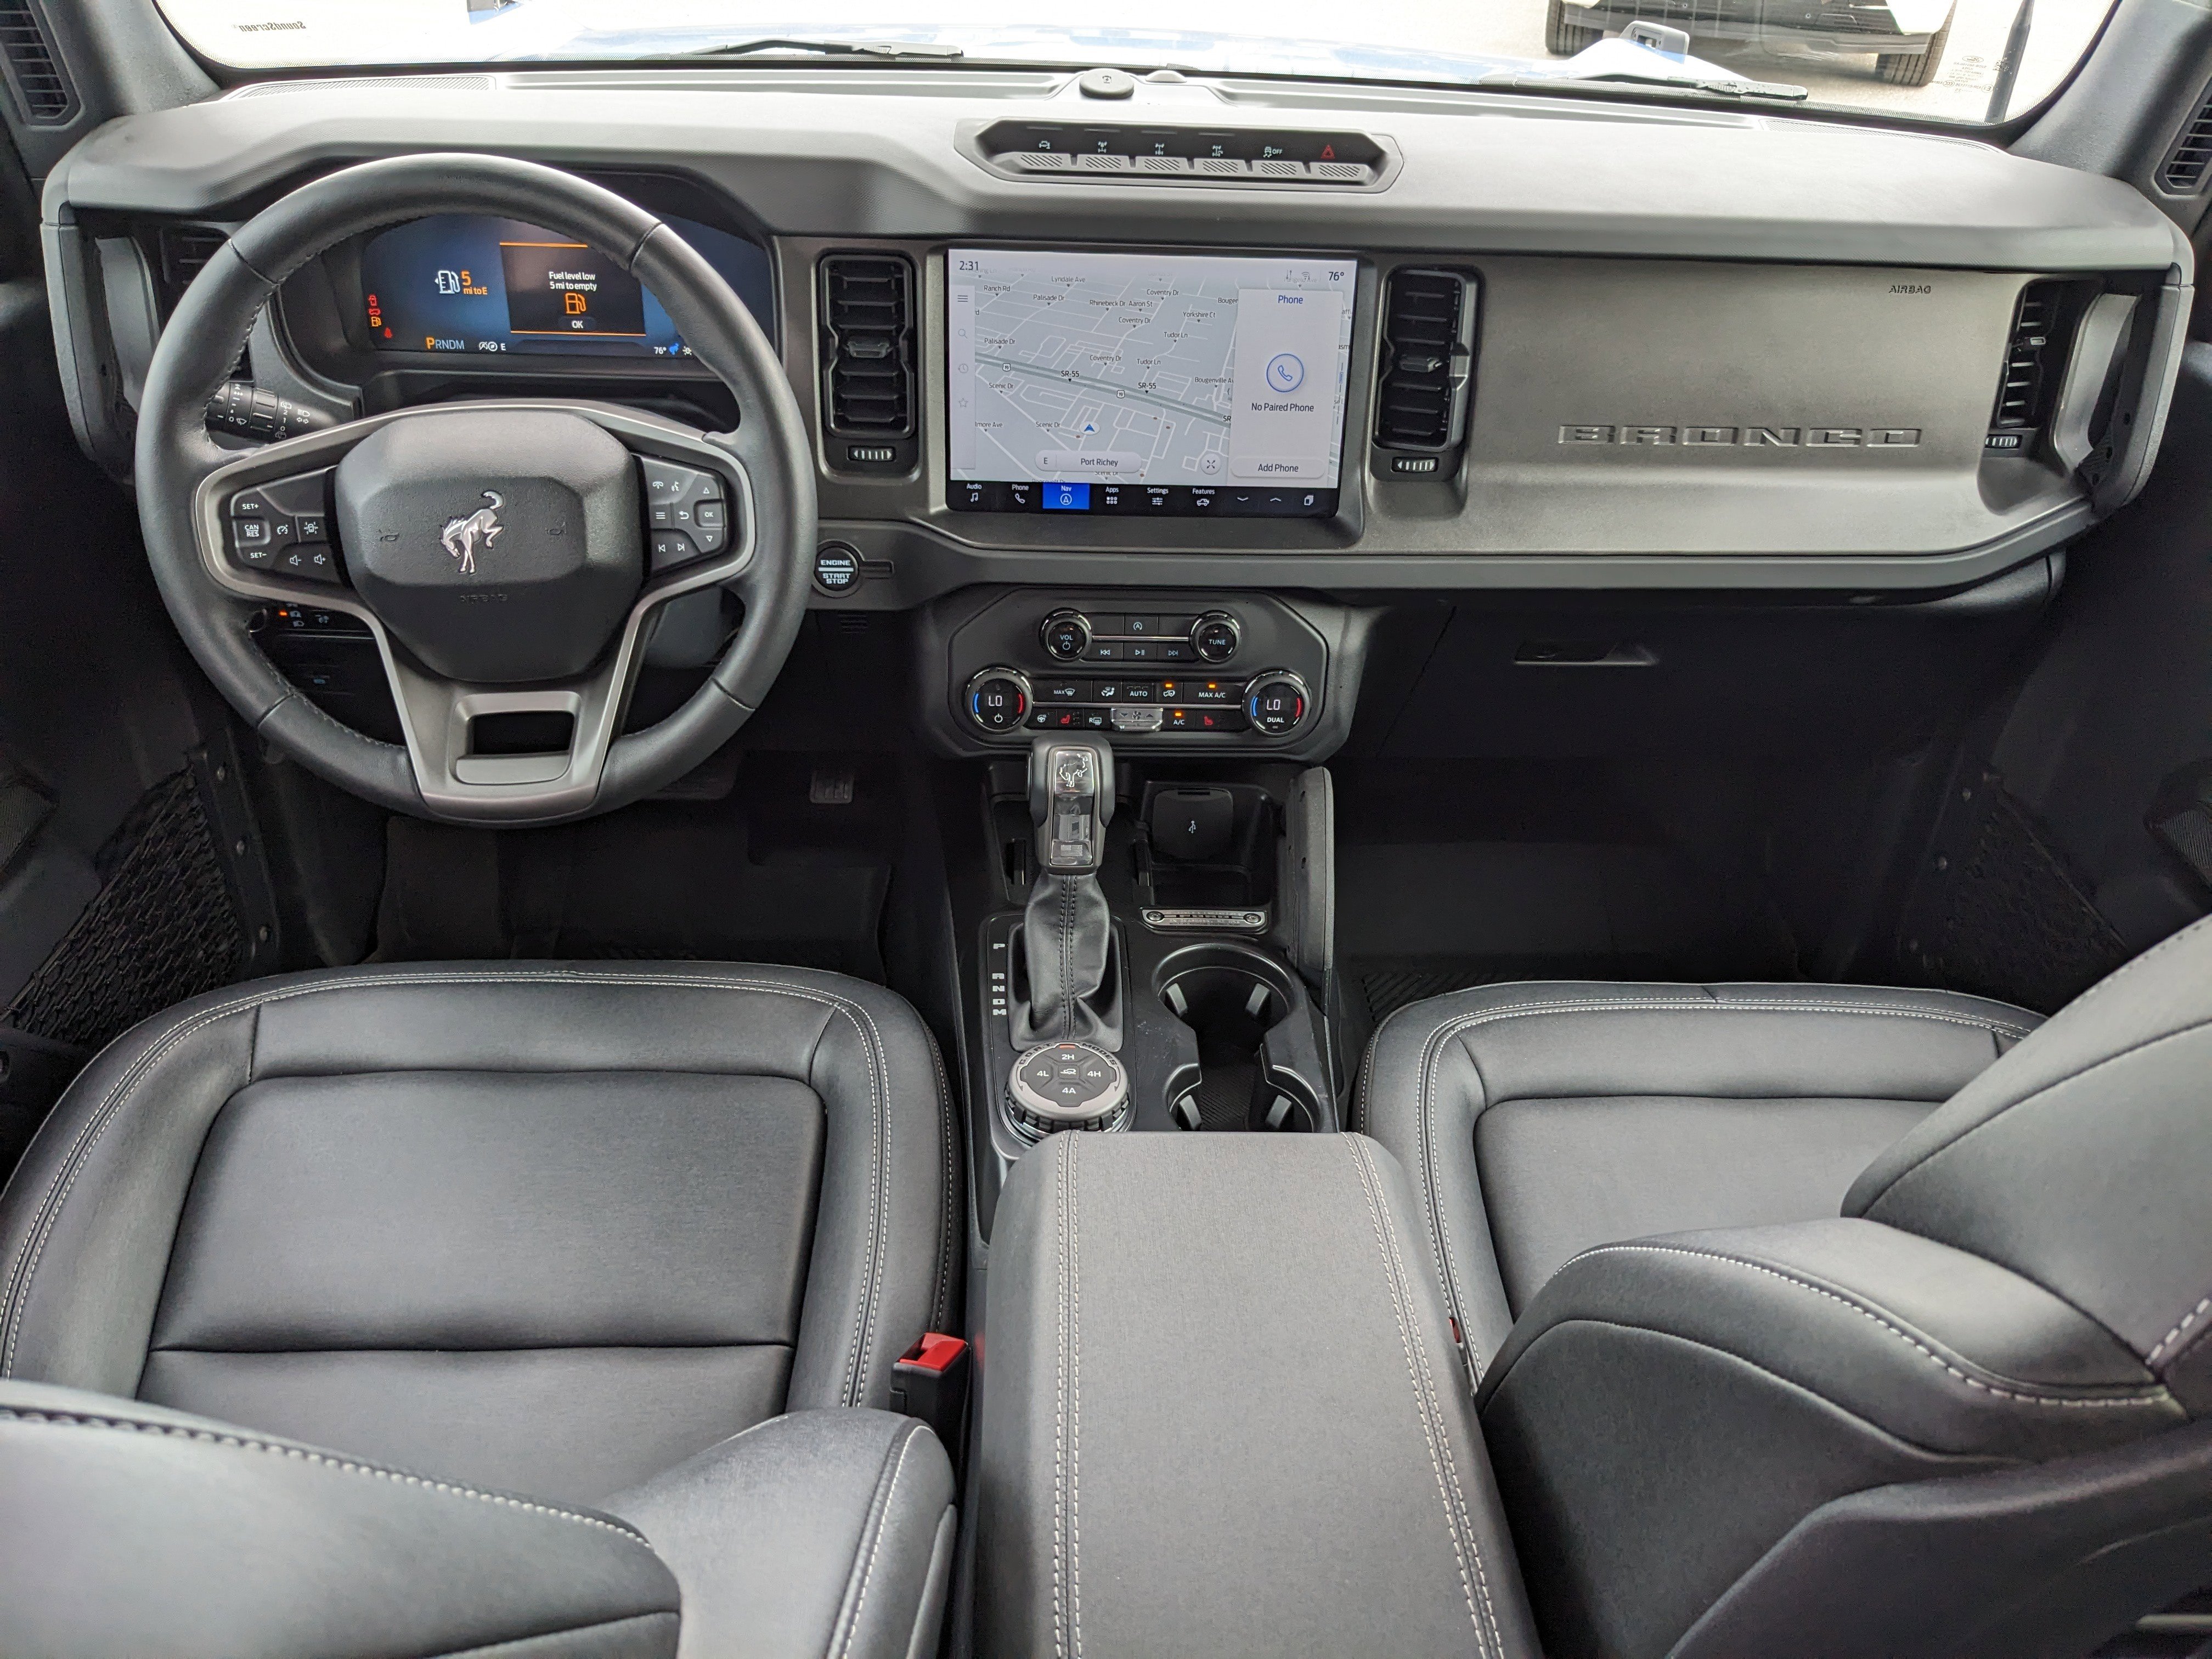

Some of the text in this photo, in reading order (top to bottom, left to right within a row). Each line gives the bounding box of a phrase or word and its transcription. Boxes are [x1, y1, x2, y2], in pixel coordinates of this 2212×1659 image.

[960, 261, 979, 270] 2:31
[461, 270, 472, 286] 5
[549, 271, 596, 280] Fuel level low
[1328, 271, 1345, 281] 76°
[549, 281, 555, 289] 5
[556, 281, 565, 290] mi
[574, 283, 597, 291] empty
[1888, 285, 1932, 295] AIRBAG
[483, 287, 488, 295] E
[1146, 289, 1171, 297] Coventry
[1278, 295, 1304, 304] Phone
[571, 320, 584, 329] OK
[500, 343, 506, 351] E
[653, 346, 667, 354] 76°
[1251, 403, 1314, 412] No Paired Phone
[1558, 425, 1922, 448] BRONCO
[1097, 459, 1118, 467] Richey
[1258, 464, 1299, 472] Add Phone
[1082, 1043, 1118, 1065] MODES
